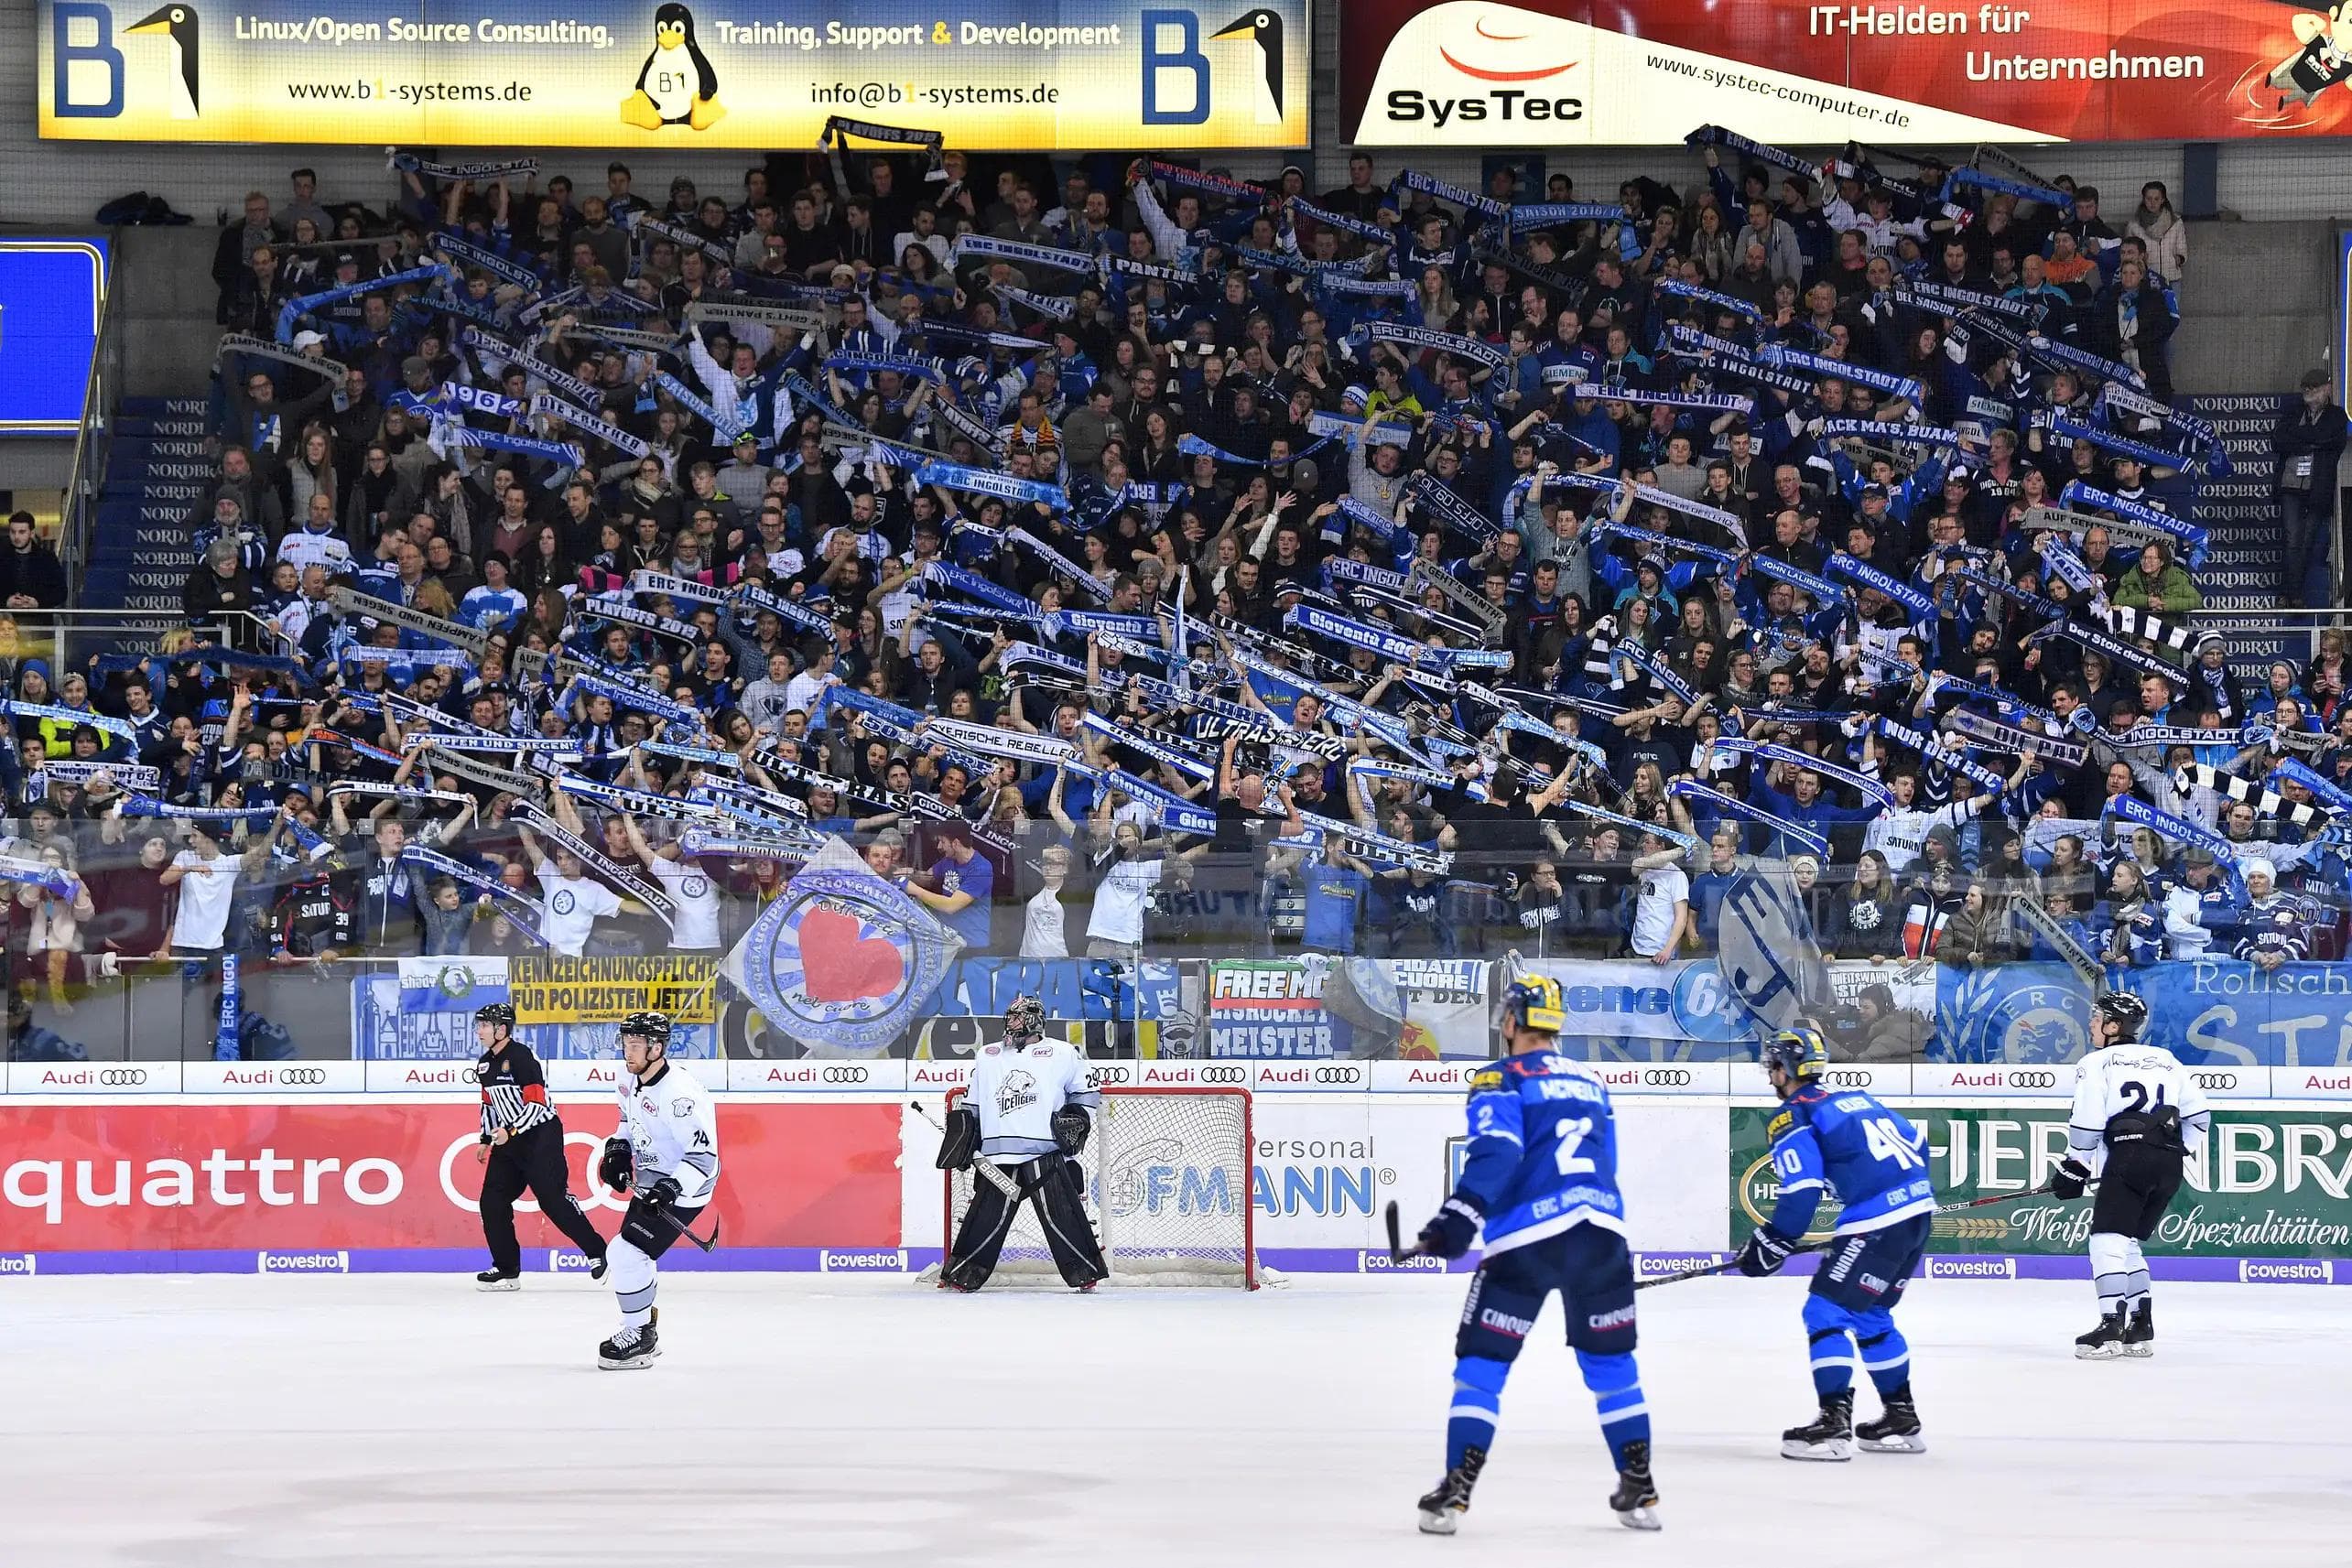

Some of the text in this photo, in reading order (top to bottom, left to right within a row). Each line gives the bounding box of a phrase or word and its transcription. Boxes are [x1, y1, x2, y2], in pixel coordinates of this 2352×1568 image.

[236, 15, 614, 48] Linux/Open Source Consulting,
[1810, 4, 2030, 36] IT-Helden für
[716, 20, 1121, 50] Training, Support & Development
[1966, 51, 2204, 81] Unternehmen
[287, 79, 532, 103] www.b1-systems.de
[810, 81, 1059, 108] info@b1-systems.de
[1647, 54, 1910, 128] www.systec-computer.de
[1387, 90, 1582, 127] SysTec
[1726, 134, 1751, 153] ERC
[1407, 169, 1433, 193] ERC
[1515, 205, 1567, 219] SAISON
[439, 236, 468, 256] ERC
[996, 241, 1090, 270] INGOLSTADT
[1896, 290, 1956, 314] DEL SAISON
[1913, 279, 2031, 317] ERC INGOLSTADT
[1374, 321, 1502, 365] ERC INGOLSTADT
[1674, 326, 1699, 345] ERC
[478, 333, 596, 402] ERC INGOLSTADT
[1541, 365, 1588, 384] SIEMENS
[1785, 351, 1899, 391] ERC INGOLSTADT
[660, 373, 709, 413] SAISON
[1597, 385, 1740, 409] ERC INGOLSTADT
[2193, 396, 2281, 412] NORDBRÄU
[477, 429, 561, 455] ERC Ingolstadt
[951, 474, 1036, 499] ERC INGOLSTADT
[2084, 487, 2195, 535] ERC INGOLSTADT
[2192, 504, 2282, 521] NORDBRÄU
[2043, 512, 2069, 523] AUF
[2116, 524, 2175, 548] PANTHER
[949, 569, 970, 585] ERC
[1331, 560, 1360, 578] ERC
[1427, 565, 1464, 594] GEHT'S
[1761, 560, 1836, 594] JOHN LALIBERTE
[2191, 571, 2282, 587] NORDBRÄU
[648, 576, 676, 591] ERC
[1831, 554, 1934, 613] ERC INGOLSTADT
[751, 588, 775, 608] ERC
[352, 595, 488, 646] KÄMPFEN UND SIEGEN
[586, 598, 657, 626] PLAYOFFS
[1027, 644, 1053, 661] ERC
[2068, 622, 2089, 639] Der
[2091, 632, 2120, 655] Stolz
[2122, 648, 2143, 664] der
[519, 654, 541, 665] AUF
[1137, 676, 1173, 697] 50
[612, 687, 681, 720] Ingolstadt
[863, 715, 896, 739] 50
[2130, 728, 2238, 743] INGOLSTADT
[408, 733, 575, 752] KÄMPFEN UND SIEGEN!
[1006, 738, 1081, 758] REBELLEN
[1196, 716, 1276, 744] ULTRAS
[1302, 730, 1346, 762] ERC
[1993, 726, 2083, 766] DIE PAN
[1884, 719, 1924, 750] NUR
[1927, 739, 1964, 768] DER
[1959, 762, 2004, 791] ERC
[464, 764, 491, 779] UND
[2125, 802, 2151, 822] ERC
[2156, 814, 2234, 860] INGOLSTADT
[736, 844, 806, 862] Ingolstadt
[1886, 836, 1920, 853] SATURN
[597, 857, 673, 911] INGOLSTADT
[335, 913, 349, 926] 39
[400, 973, 506, 989] shady CREW
[510, 956, 717, 984] KENNZEICHNUNGSPFLICHT
[1395, 973, 1469, 989] CUORE
[1215, 969, 1290, 1000] FREE
[513, 985, 703, 1012] FÜR POLIZISTEN JETZT
[792, 990, 872, 1013] nel cuore
[1434, 989, 1482, 1005] DEN
[1210, 1025, 1333, 1057] MEISTER
[41, 1069, 93, 1085] Audi
[222, 1069, 274, 1085] Audi
[406, 1068, 456, 1084] Audi
[767, 1067, 816, 1083] Audi
[914, 1068, 965, 1083] Audi
[1086, 1074, 1100, 1088] 29
[1144, 1067, 1195, 1082] Audi
[1259, 1067, 1310, 1082] Audi
[1409, 1067, 1458, 1084] Audi
[1951, 1073, 2003, 1087] Audi
[1478, 1105, 1493, 1130] 2
[693, 1129, 710, 1148] 74
[1555, 1117, 1596, 1175] 2
[3, 1148, 405, 1225] quattro
[979, 1162, 1019, 1196] BAUER
[1532, 1197, 1556, 1219] ERC
[1887, 1188, 1908, 1206] ERC
[266, 1252, 340, 1271] covestro
[827, 1251, 899, 1268] covestro
[1642, 1255, 1713, 1271] covestro
[1828, 1238, 1866, 1282] SATURN
[1933, 1260, 2008, 1277] covestro
[2247, 1263, 2325, 1280] covestro
